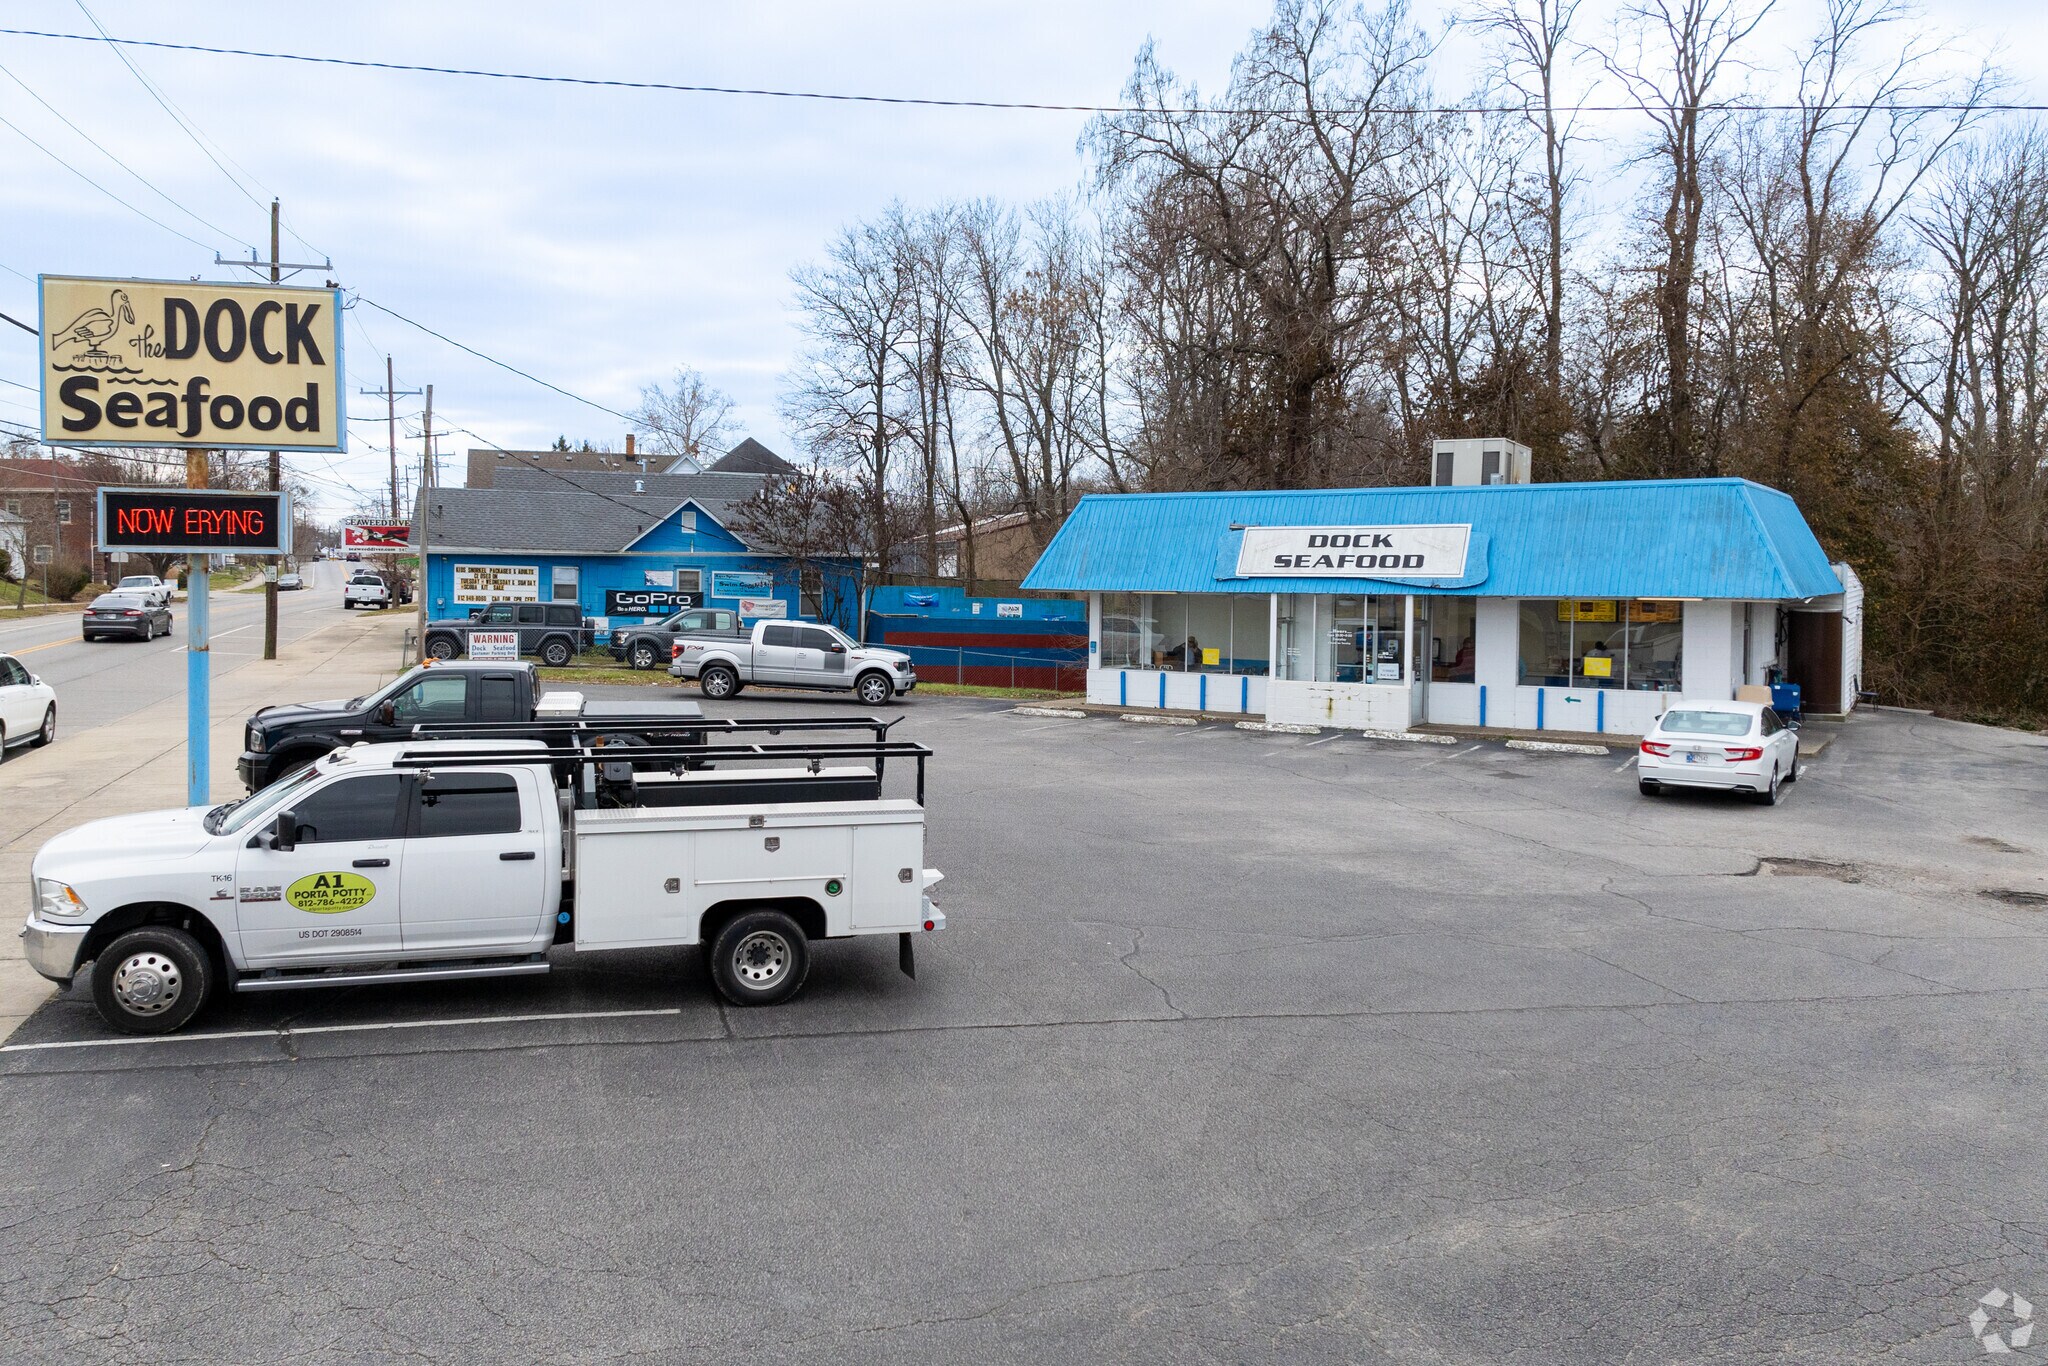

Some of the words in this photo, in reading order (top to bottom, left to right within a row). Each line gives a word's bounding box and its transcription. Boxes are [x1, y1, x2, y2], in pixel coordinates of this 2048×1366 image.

[129, 324, 166, 359] the
[164, 297, 326, 366] DOCK
[58, 375, 321, 438] Seafood
[117, 508, 175, 535] NOW
[345, 518, 387, 526] SEAWEED
[1307, 533, 1394, 548] DOCK
[1273, 554, 1426, 569] SEAFOOD
[615, 592, 691, 605] GoPro
[473, 634, 515, 644] WARNING
[211, 874, 233, 882] TK-16
[313, 874, 345, 889] A1
[294, 889, 329, 900] PORTA
[332, 888, 368, 897] POTTY
[298, 897, 364, 907] 812-786-4222
[299, 931, 310, 939] US
[312, 930, 329, 938] DOT
[330, 928, 362, 937] 2908514
